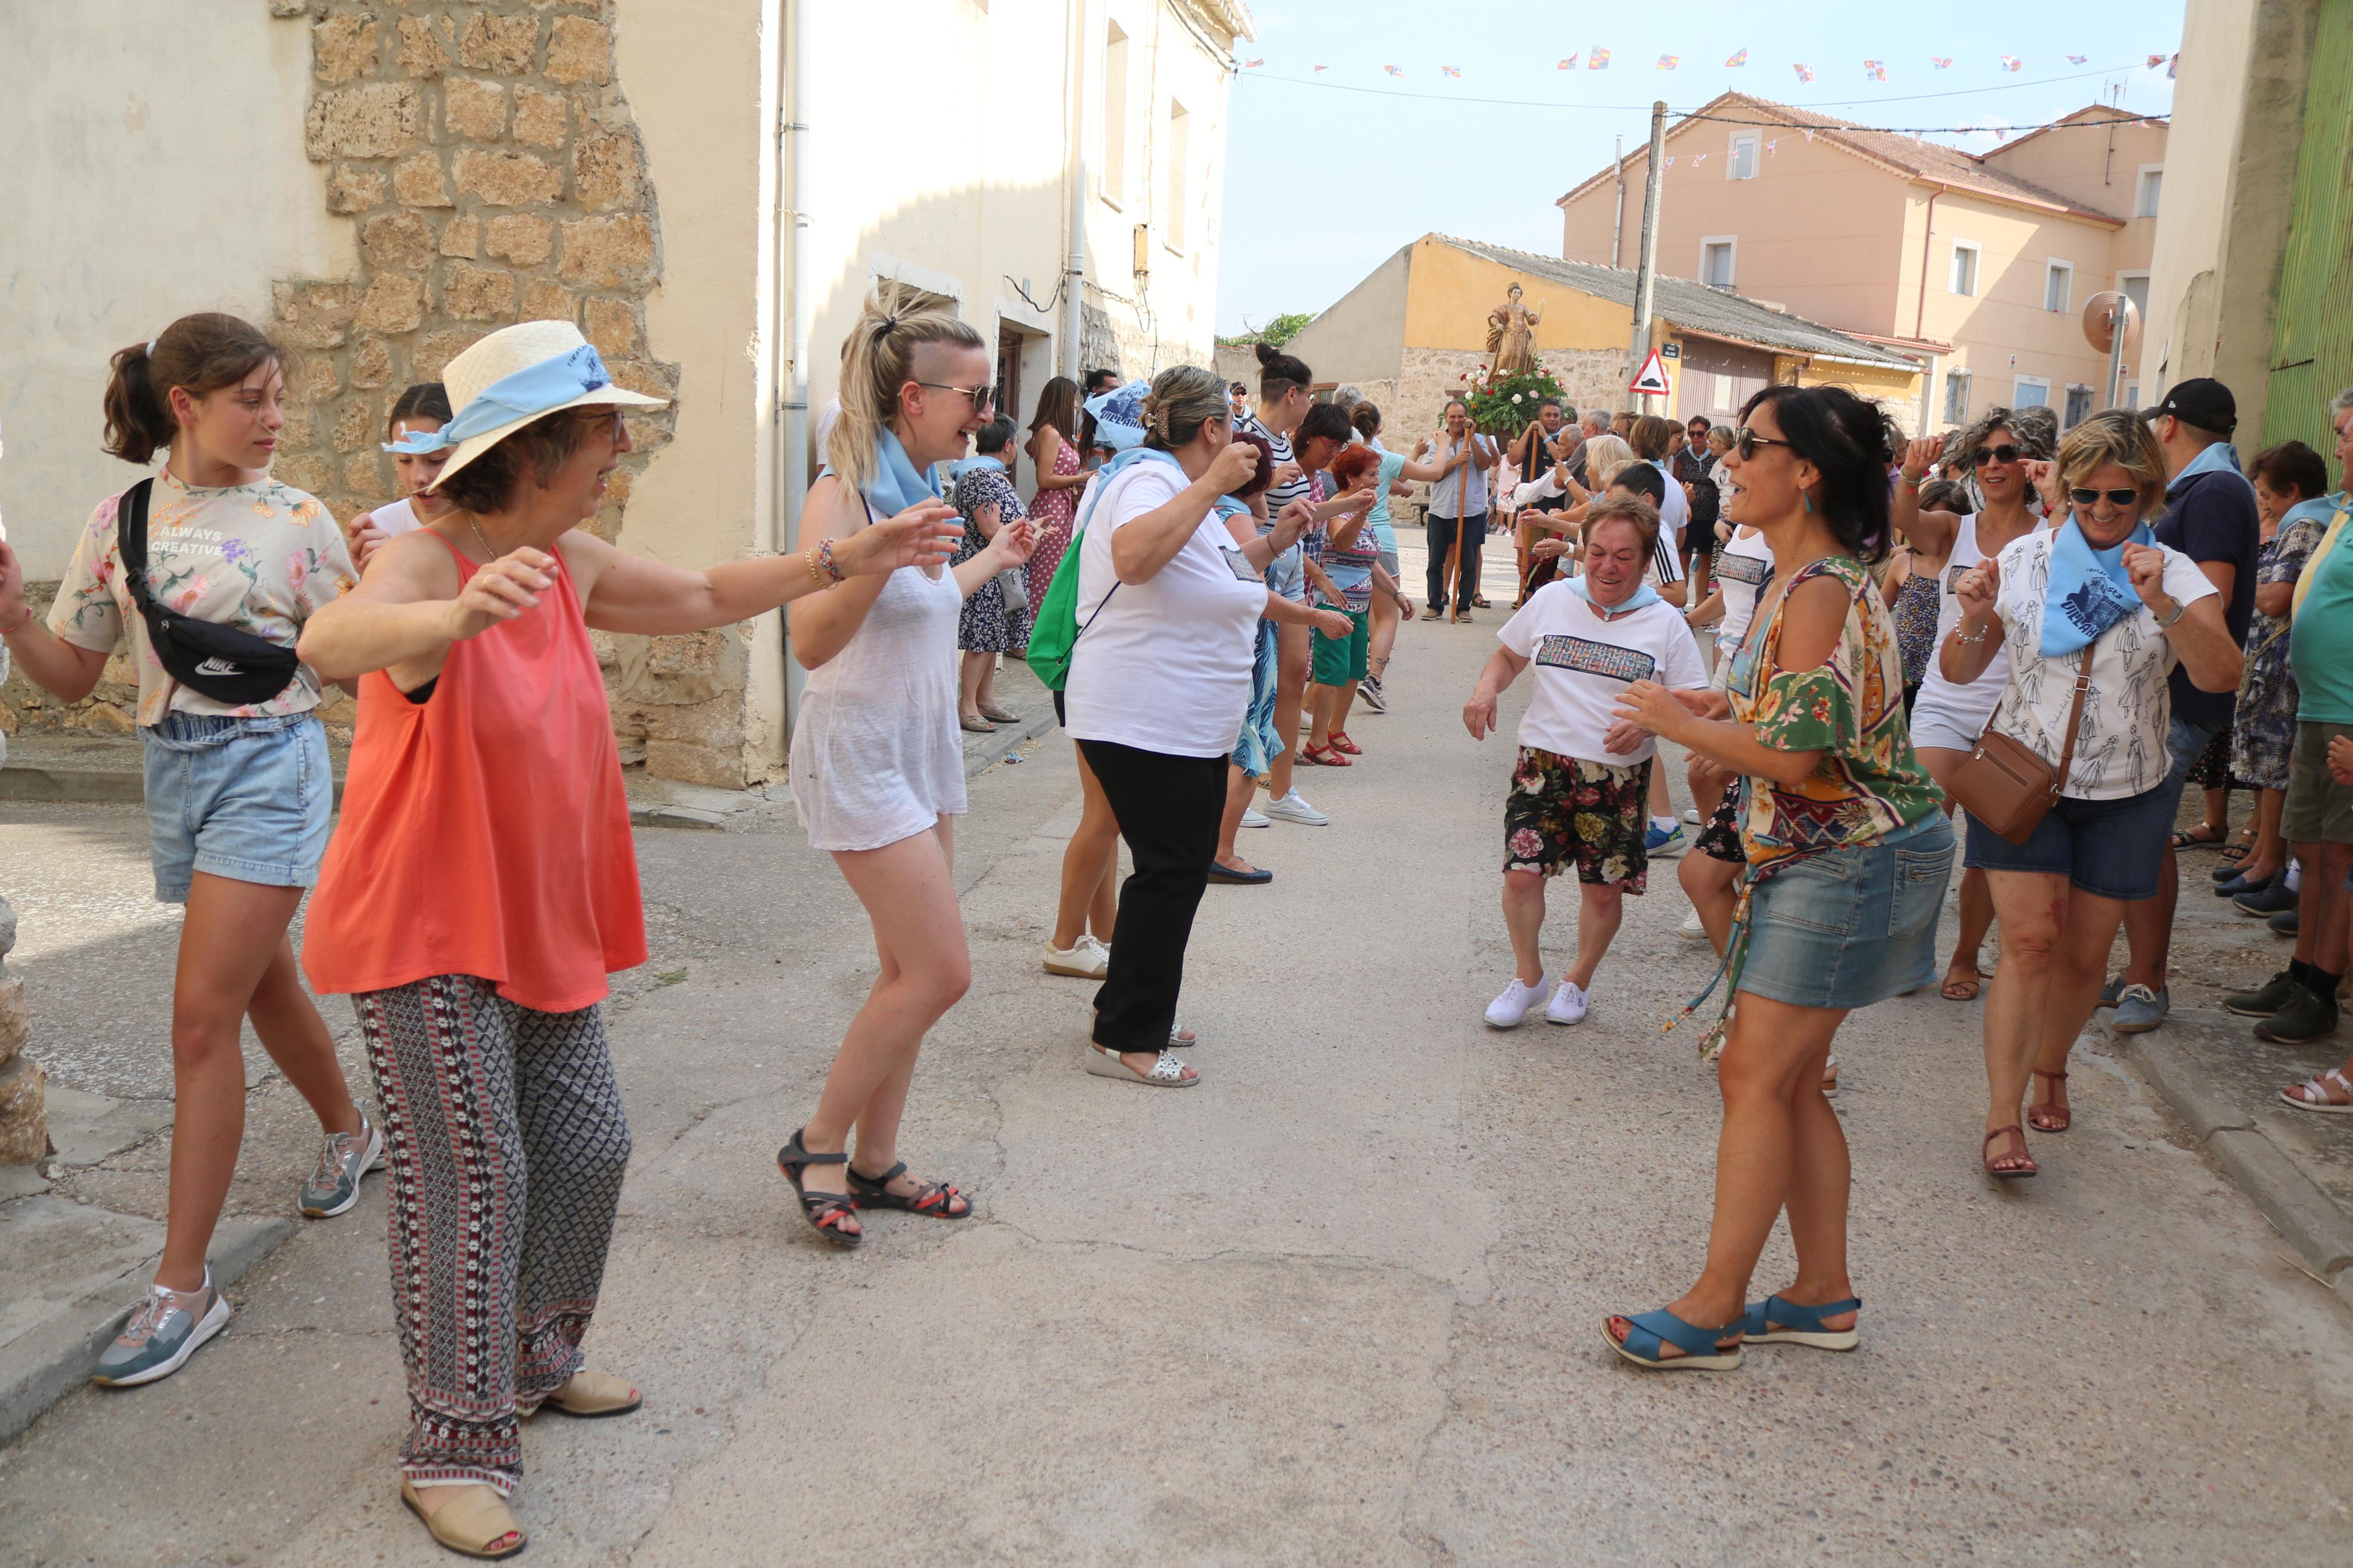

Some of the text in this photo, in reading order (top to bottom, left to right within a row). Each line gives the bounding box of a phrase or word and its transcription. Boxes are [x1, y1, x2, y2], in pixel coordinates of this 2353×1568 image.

[159, 525, 222, 542] ALWAYS
[151, 541, 223, 556] CREATIVE
[2060, 599, 2099, 639] VILLAH
[203, 656, 236, 673] NIKE
